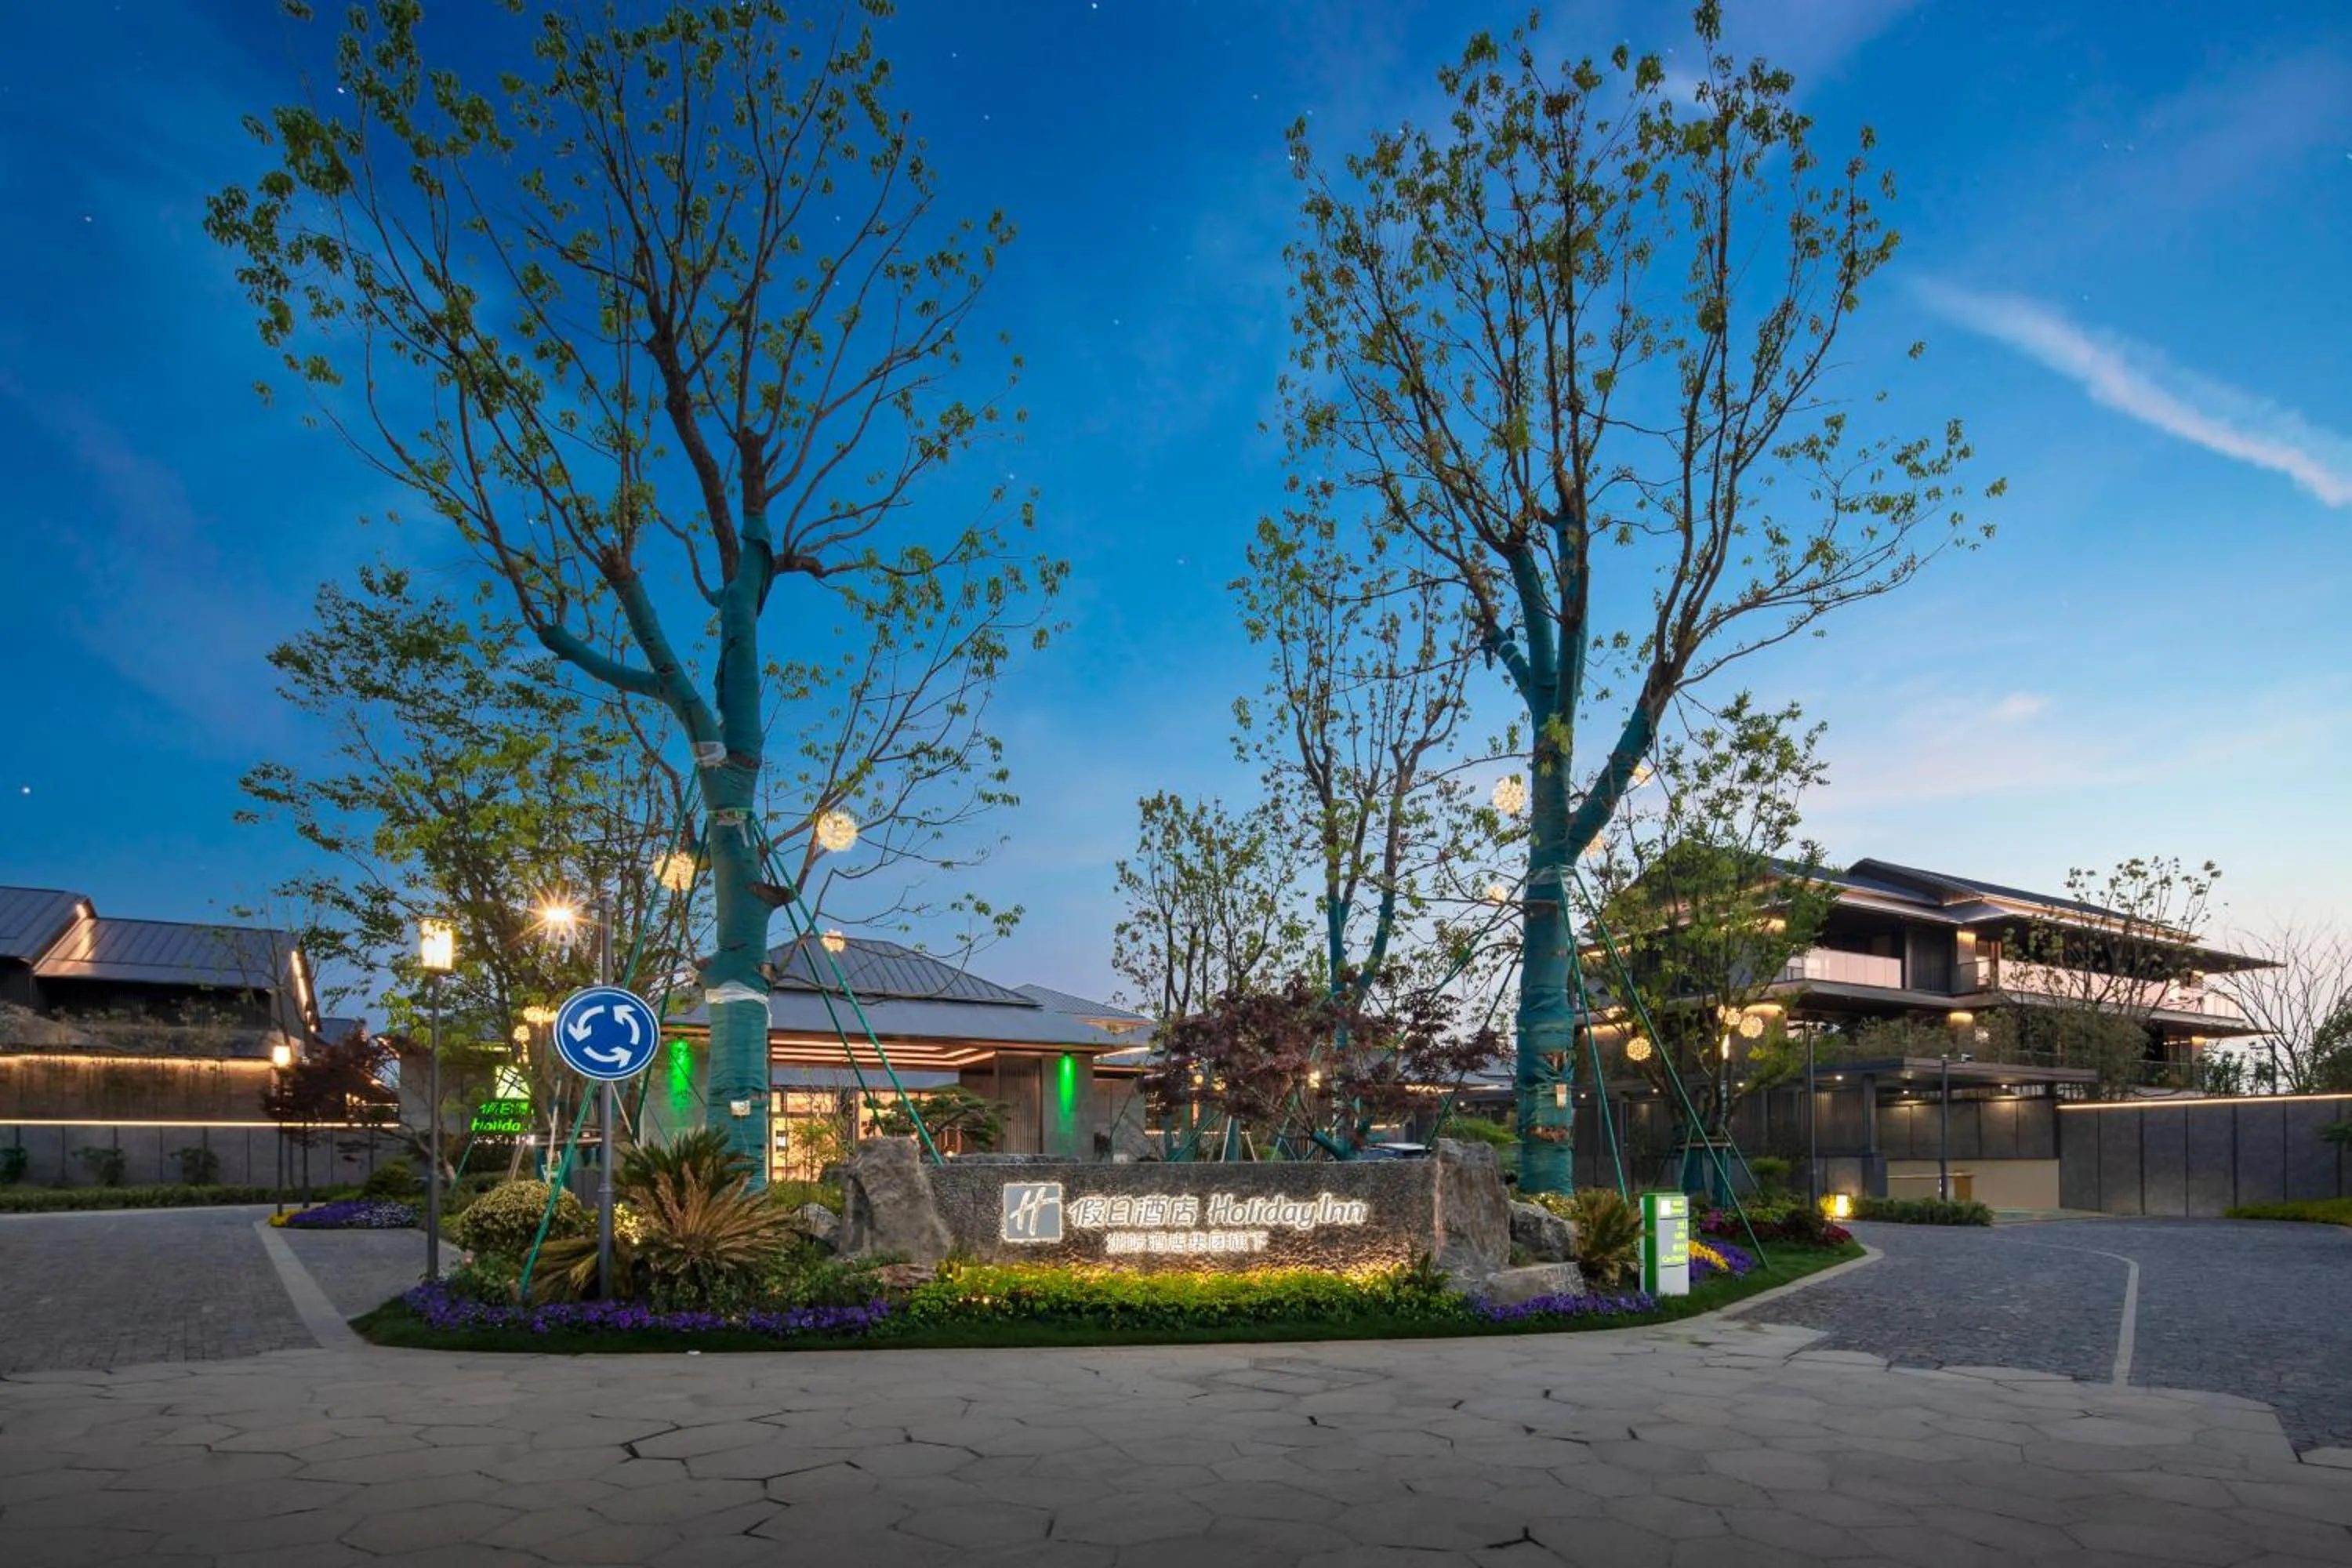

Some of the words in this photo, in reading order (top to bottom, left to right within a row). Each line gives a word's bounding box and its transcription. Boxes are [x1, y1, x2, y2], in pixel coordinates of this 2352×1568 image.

[1069, 1195, 1199, 1228] 假日酒店
[1207, 1192, 1318, 1229] Holiday
[1319, 1192, 1369, 1225] Inn
[1106, 1231, 1269, 1254] 洲际酒店集团旗下
